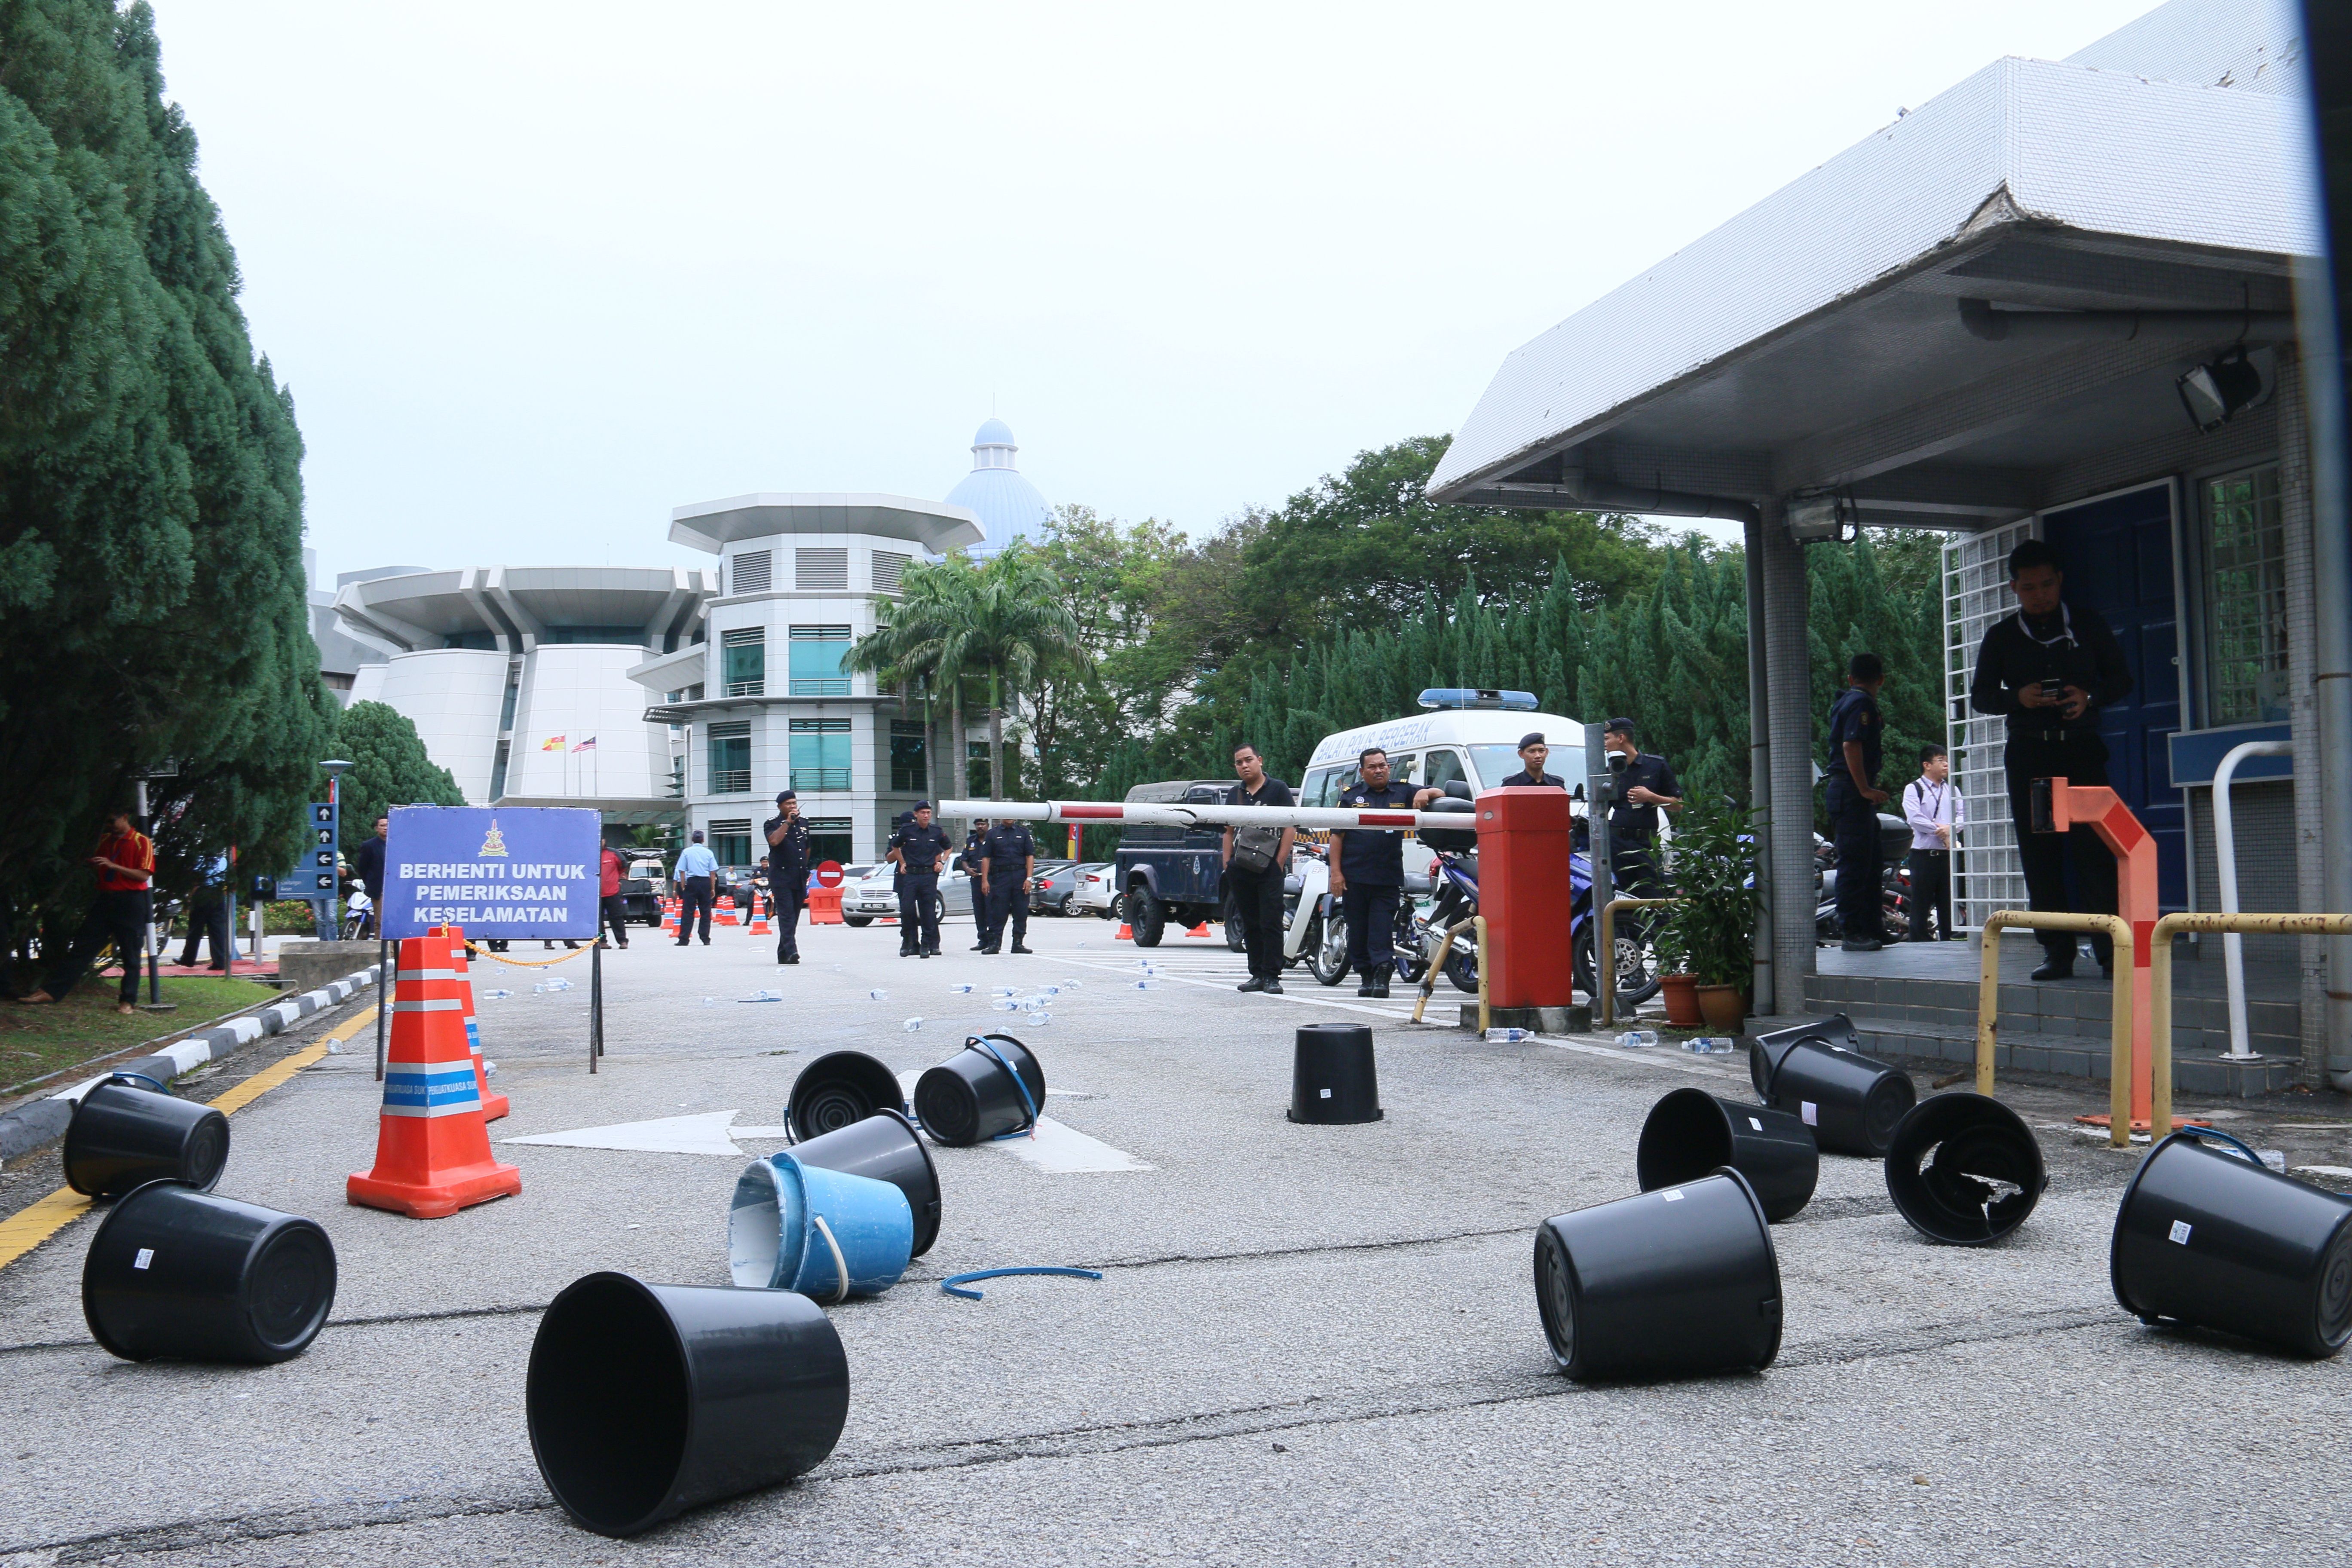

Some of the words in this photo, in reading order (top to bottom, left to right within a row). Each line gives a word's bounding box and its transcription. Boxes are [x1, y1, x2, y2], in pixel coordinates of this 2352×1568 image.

[1316, 738, 1347, 761] BALAI
[1344, 731, 1376, 756] POLIS
[1375, 720, 1436, 749] BERGERAK
[400, 864, 505, 879] BERHENTI
[512, 864, 585, 880] UNTUK
[416, 885, 567, 900] PEMERIKSAAN
[413, 907, 567, 922] KESELAMATAN
